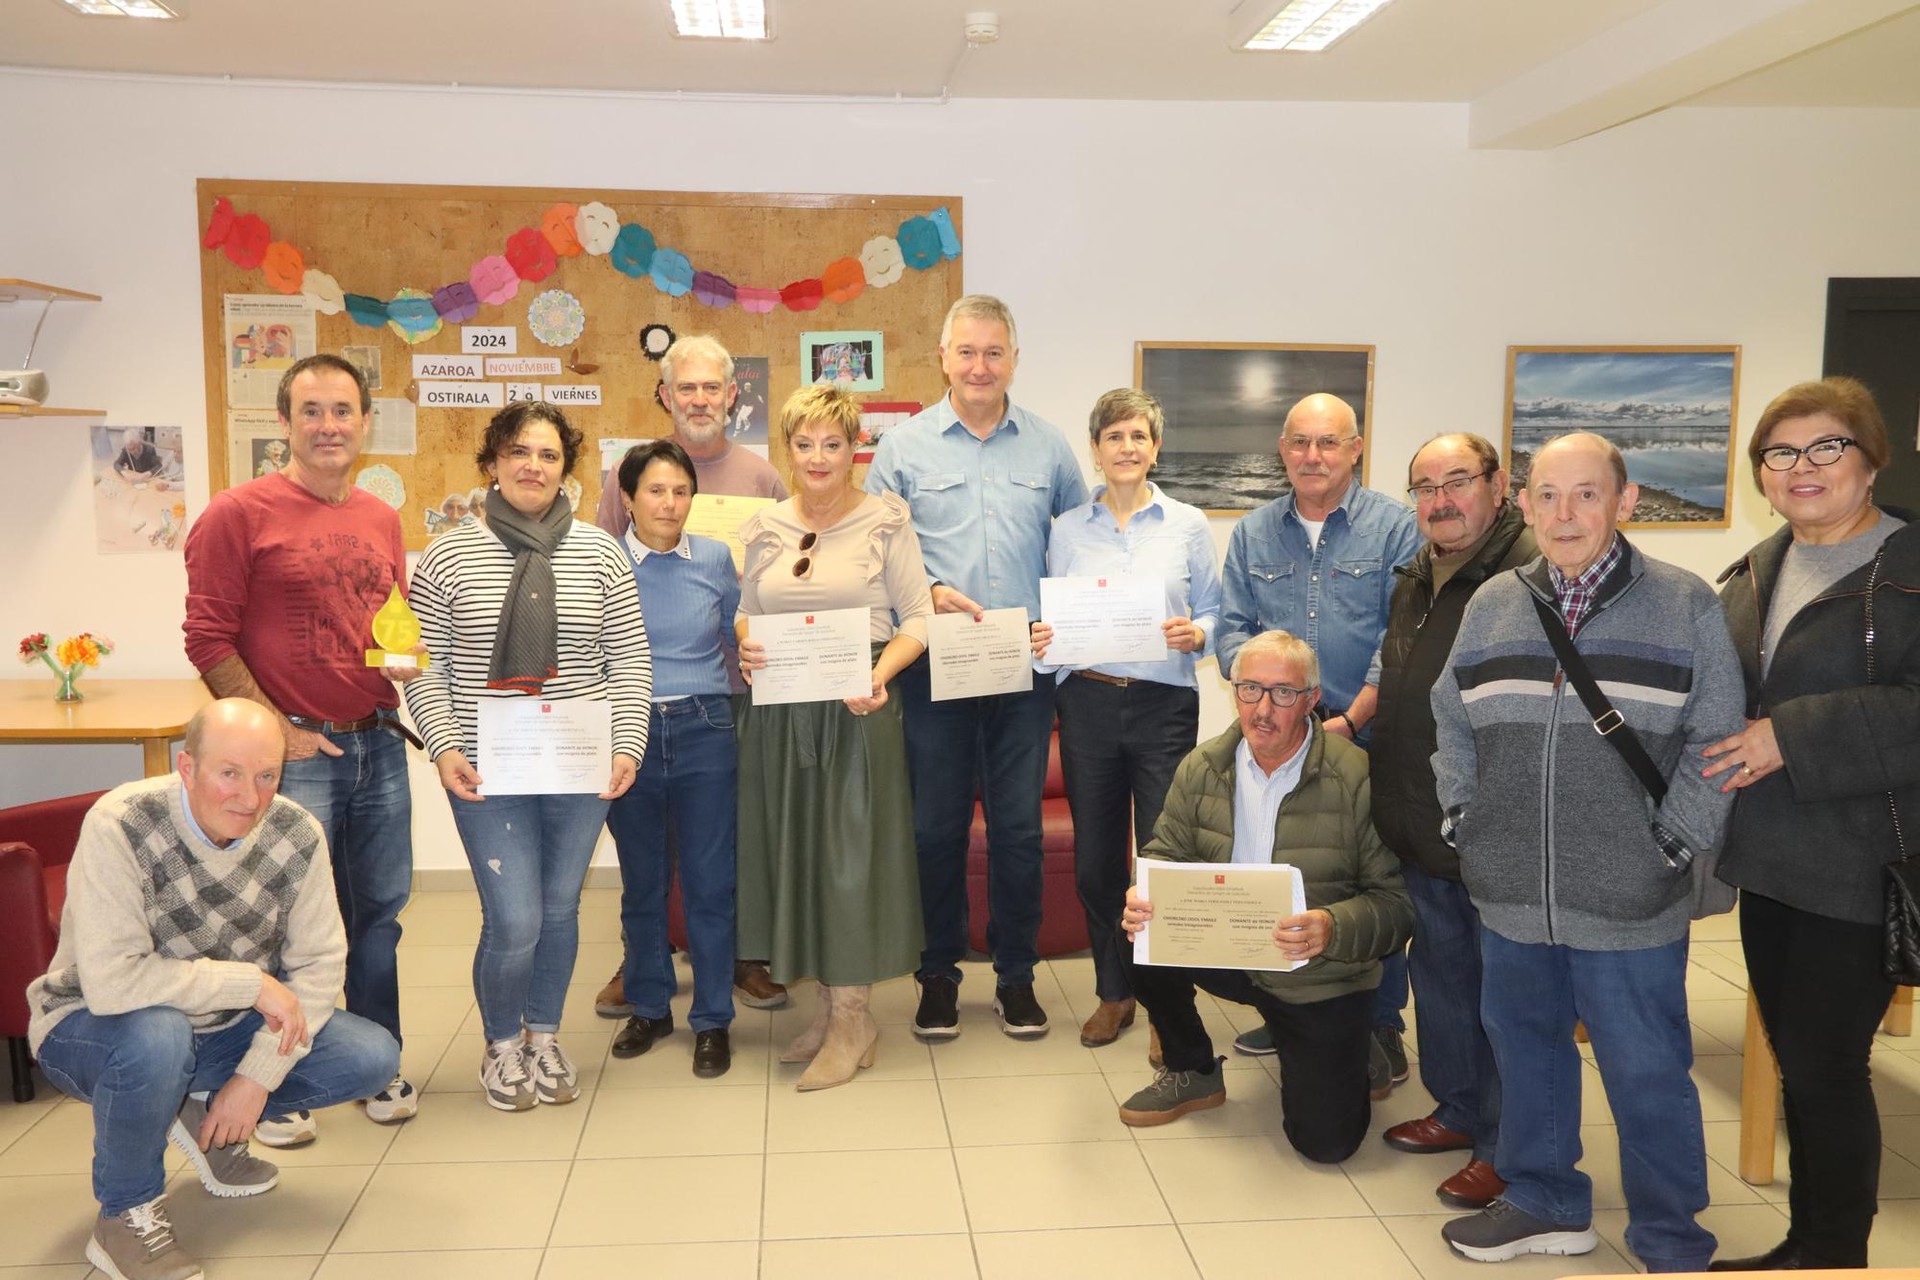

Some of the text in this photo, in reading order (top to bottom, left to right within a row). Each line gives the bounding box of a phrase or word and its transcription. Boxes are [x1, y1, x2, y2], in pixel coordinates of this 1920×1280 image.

[471, 335, 507, 347] 2024
[421, 361, 557, 377] AZAROA NOVIEMBRE
[427, 389, 597, 403] OSTIRALA 2 9 VIERNES
[380, 619, 417, 644] 75
